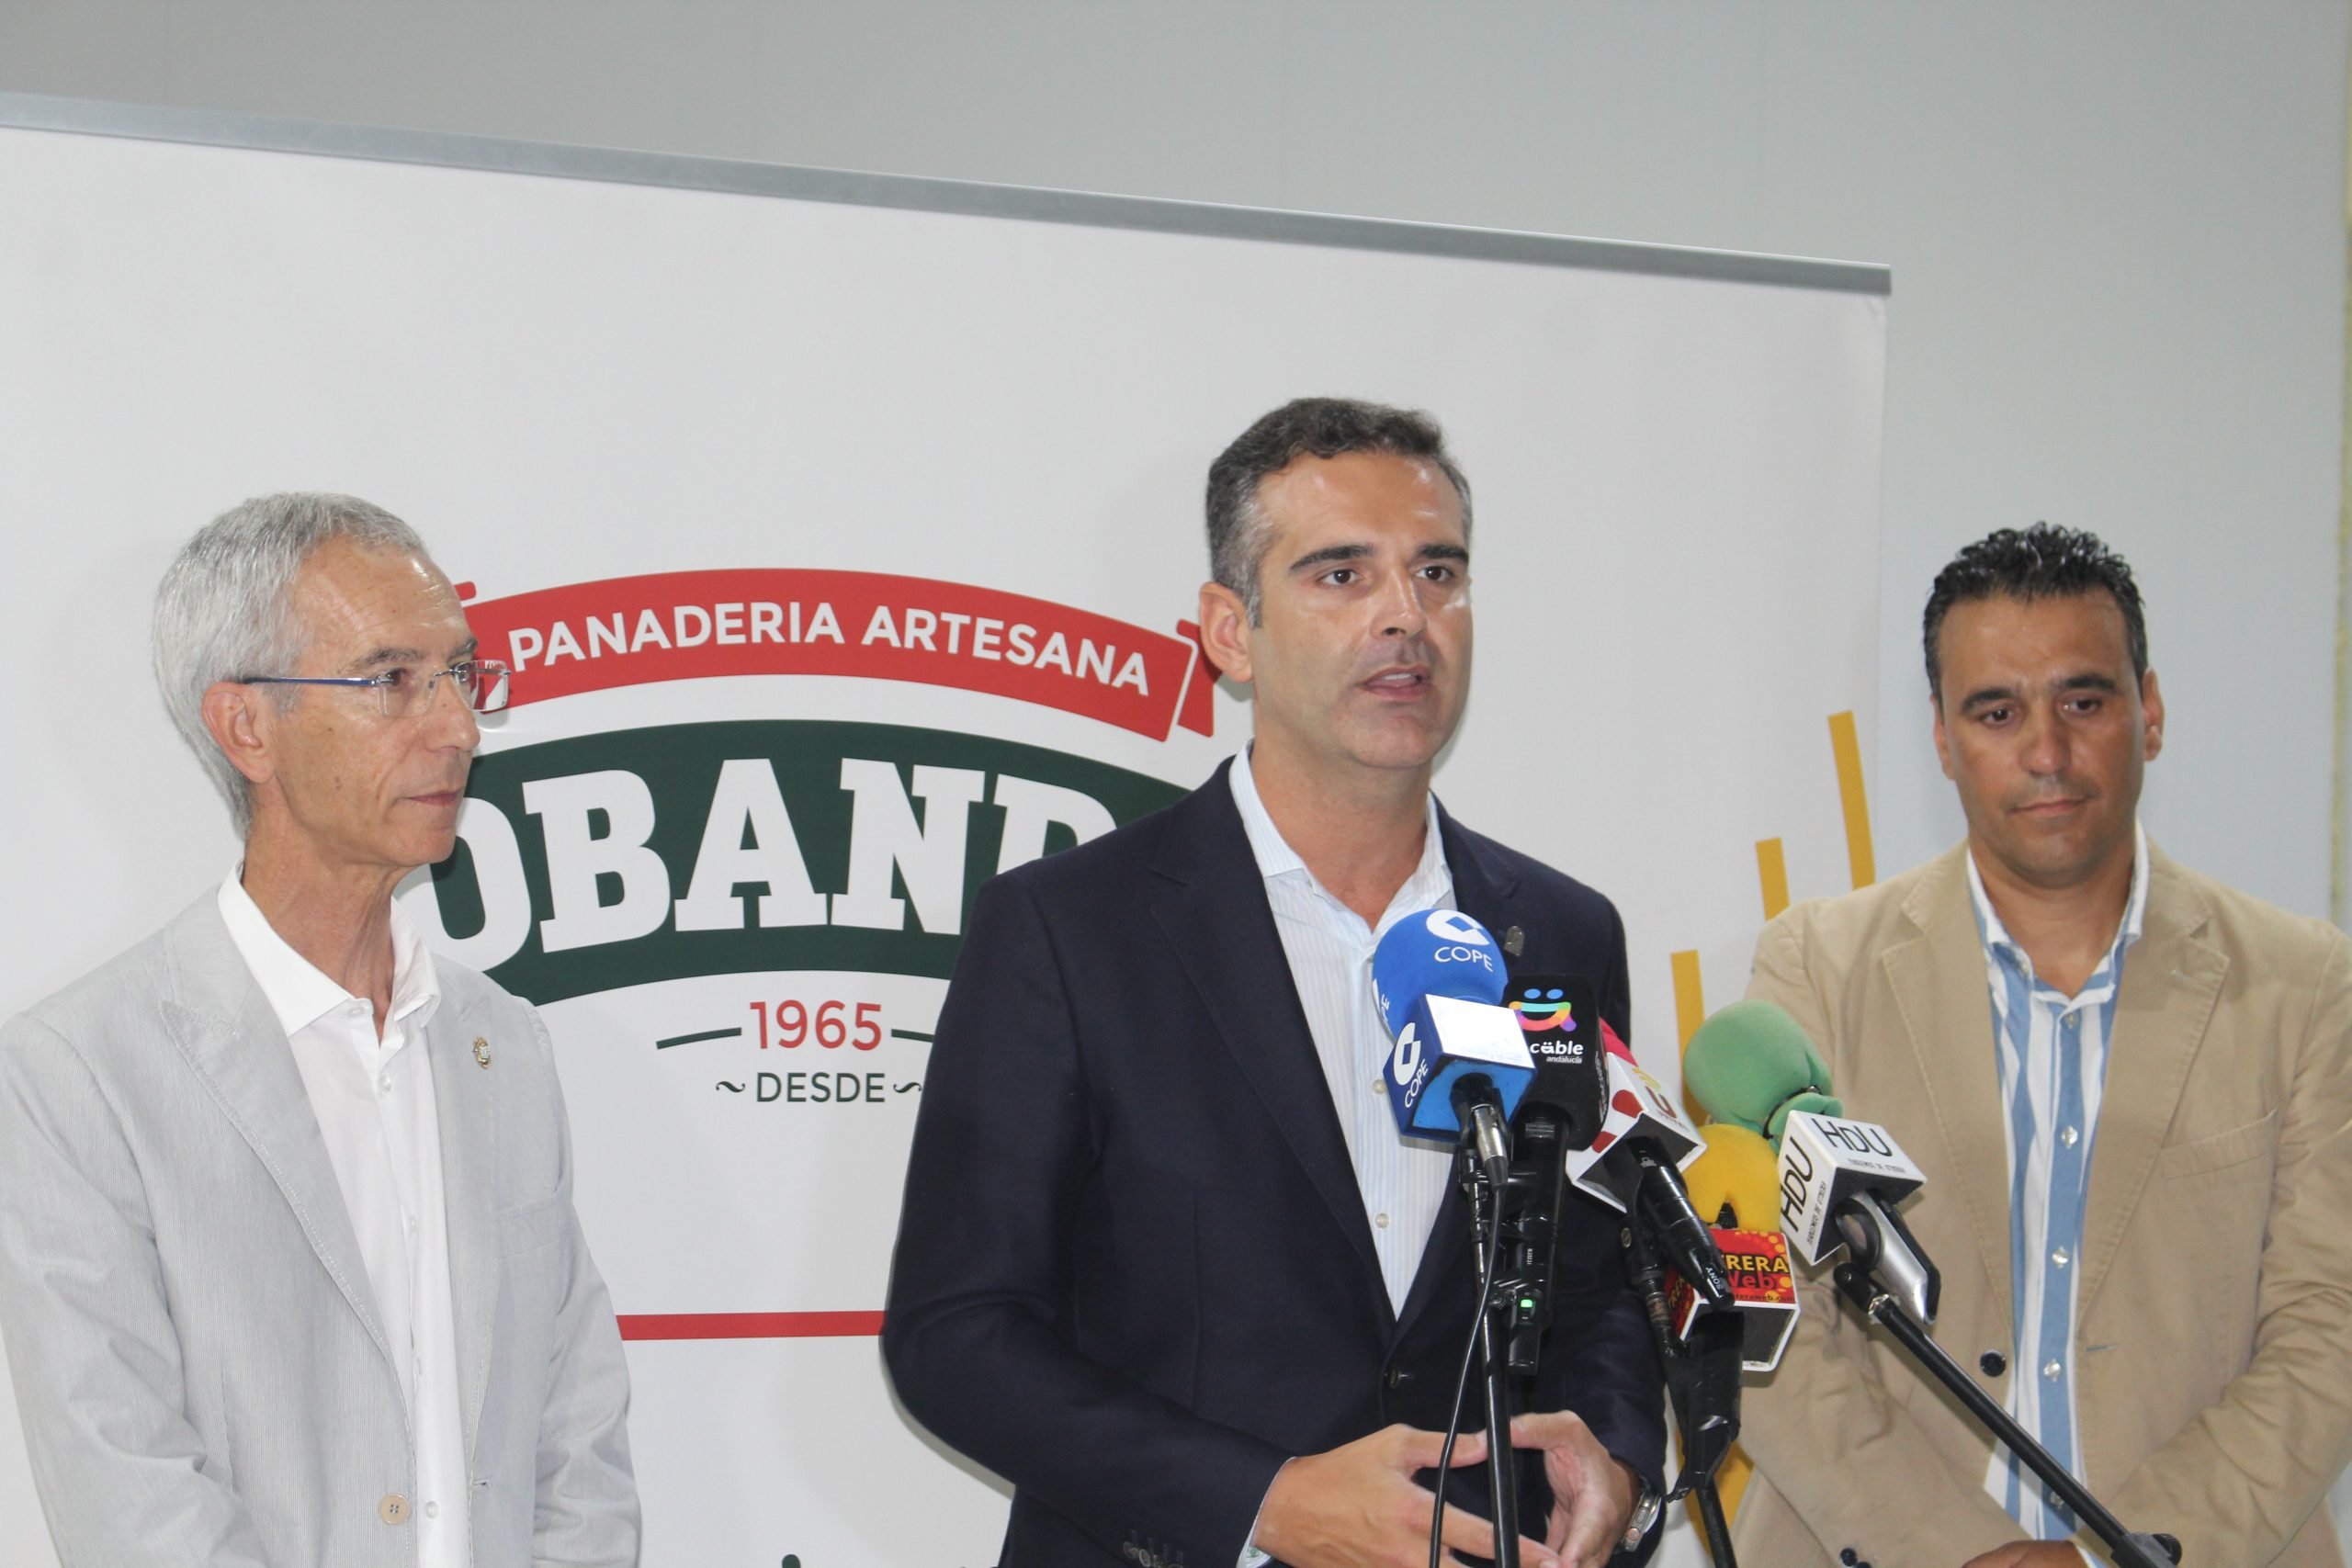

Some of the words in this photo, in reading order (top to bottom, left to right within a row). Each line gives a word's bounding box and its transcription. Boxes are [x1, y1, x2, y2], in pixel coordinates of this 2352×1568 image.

[508, 602, 845, 672] PANADERIA
[862, 604, 1150, 695] ARTESANA
[1434, 946, 1494, 973] COPE
[751, 999, 883, 1053] 1965
[756, 1072, 886, 1104] DESDE
[1405, 1058, 1429, 1109] COPE
[1811, 1117, 1893, 1157] HDU
[1780, 1135, 1814, 1233] HDU
[1724, 1254, 1790, 1273] RERA
